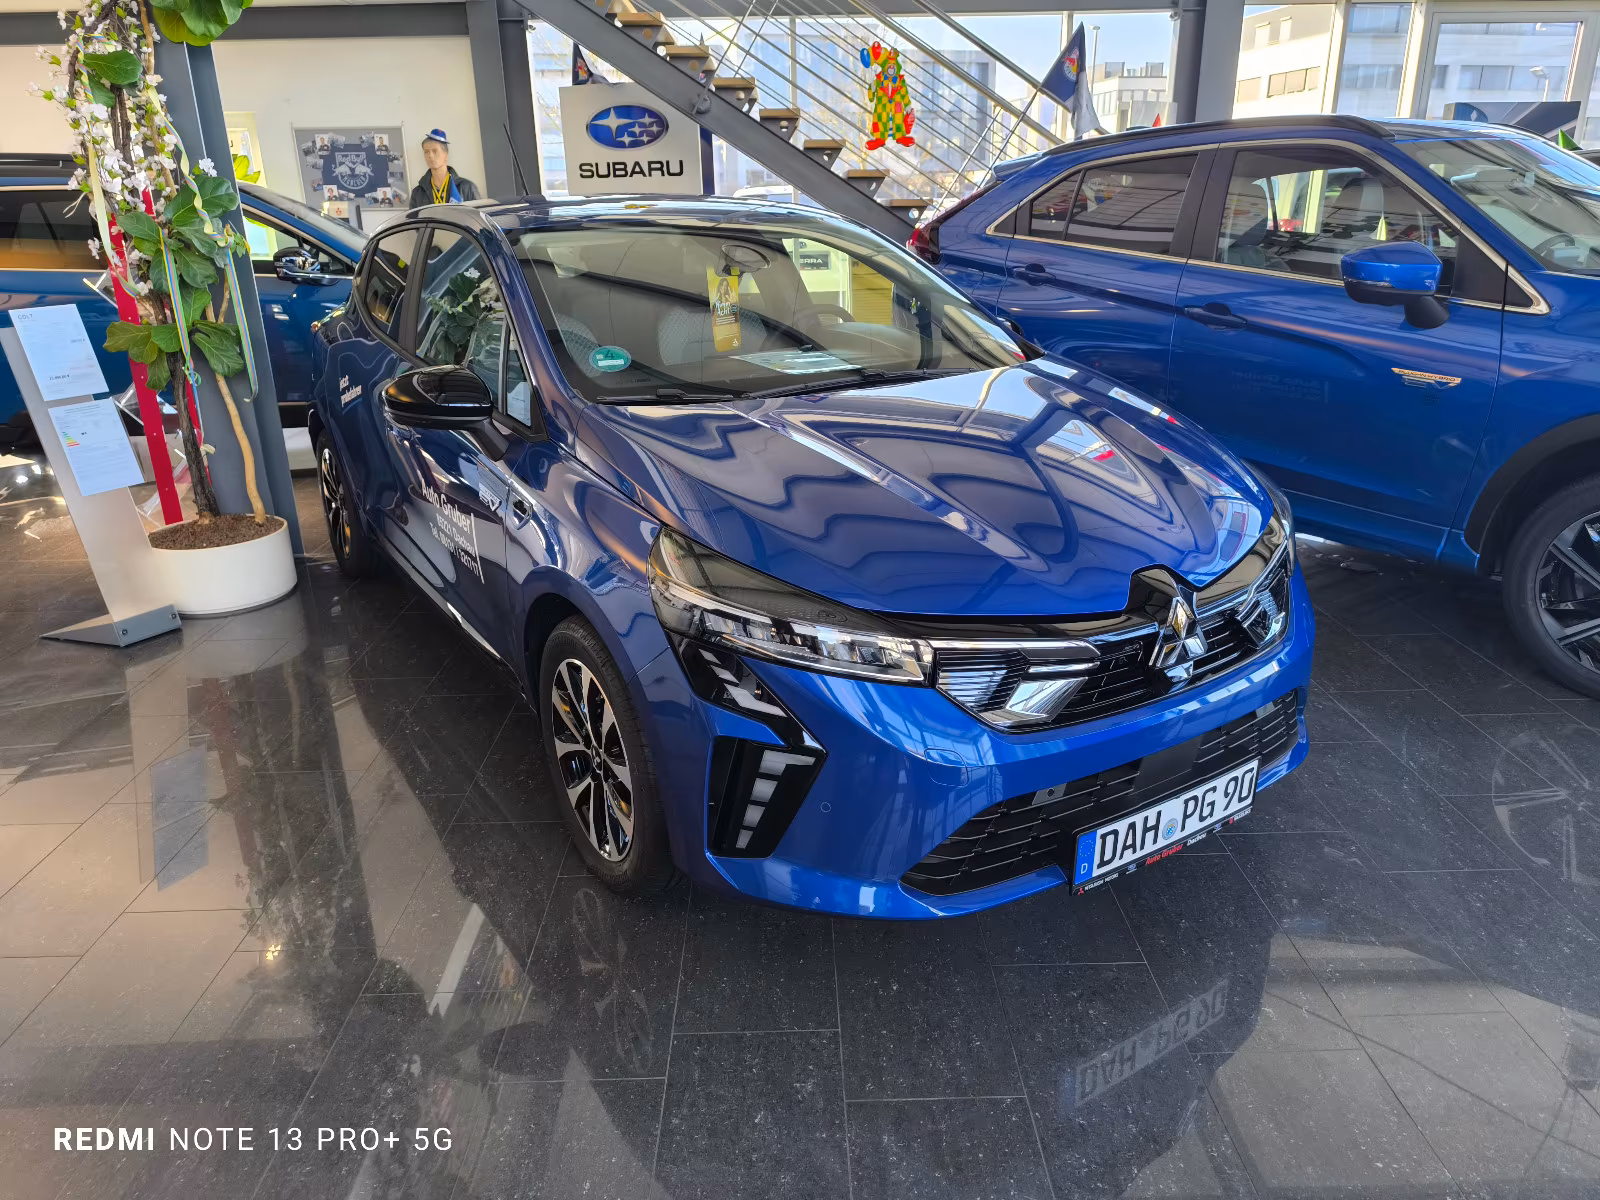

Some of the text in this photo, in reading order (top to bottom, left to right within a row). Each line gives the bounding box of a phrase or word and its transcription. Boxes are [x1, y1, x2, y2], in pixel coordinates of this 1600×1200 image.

[338, 154, 364, 163] Red Bull
[579, 160, 684, 178] SUBARU
[605, 350, 615, 359] 4
[421, 480, 471, 534] Auto Gruber
[452, 526, 476, 557] Dachau
[1097, 767, 1255, 869] DAH PG 90
[1145, 854, 1161, 865] Auto
[1161, 842, 1184, 858] Gruber
[1080, 863, 1088, 875] D
